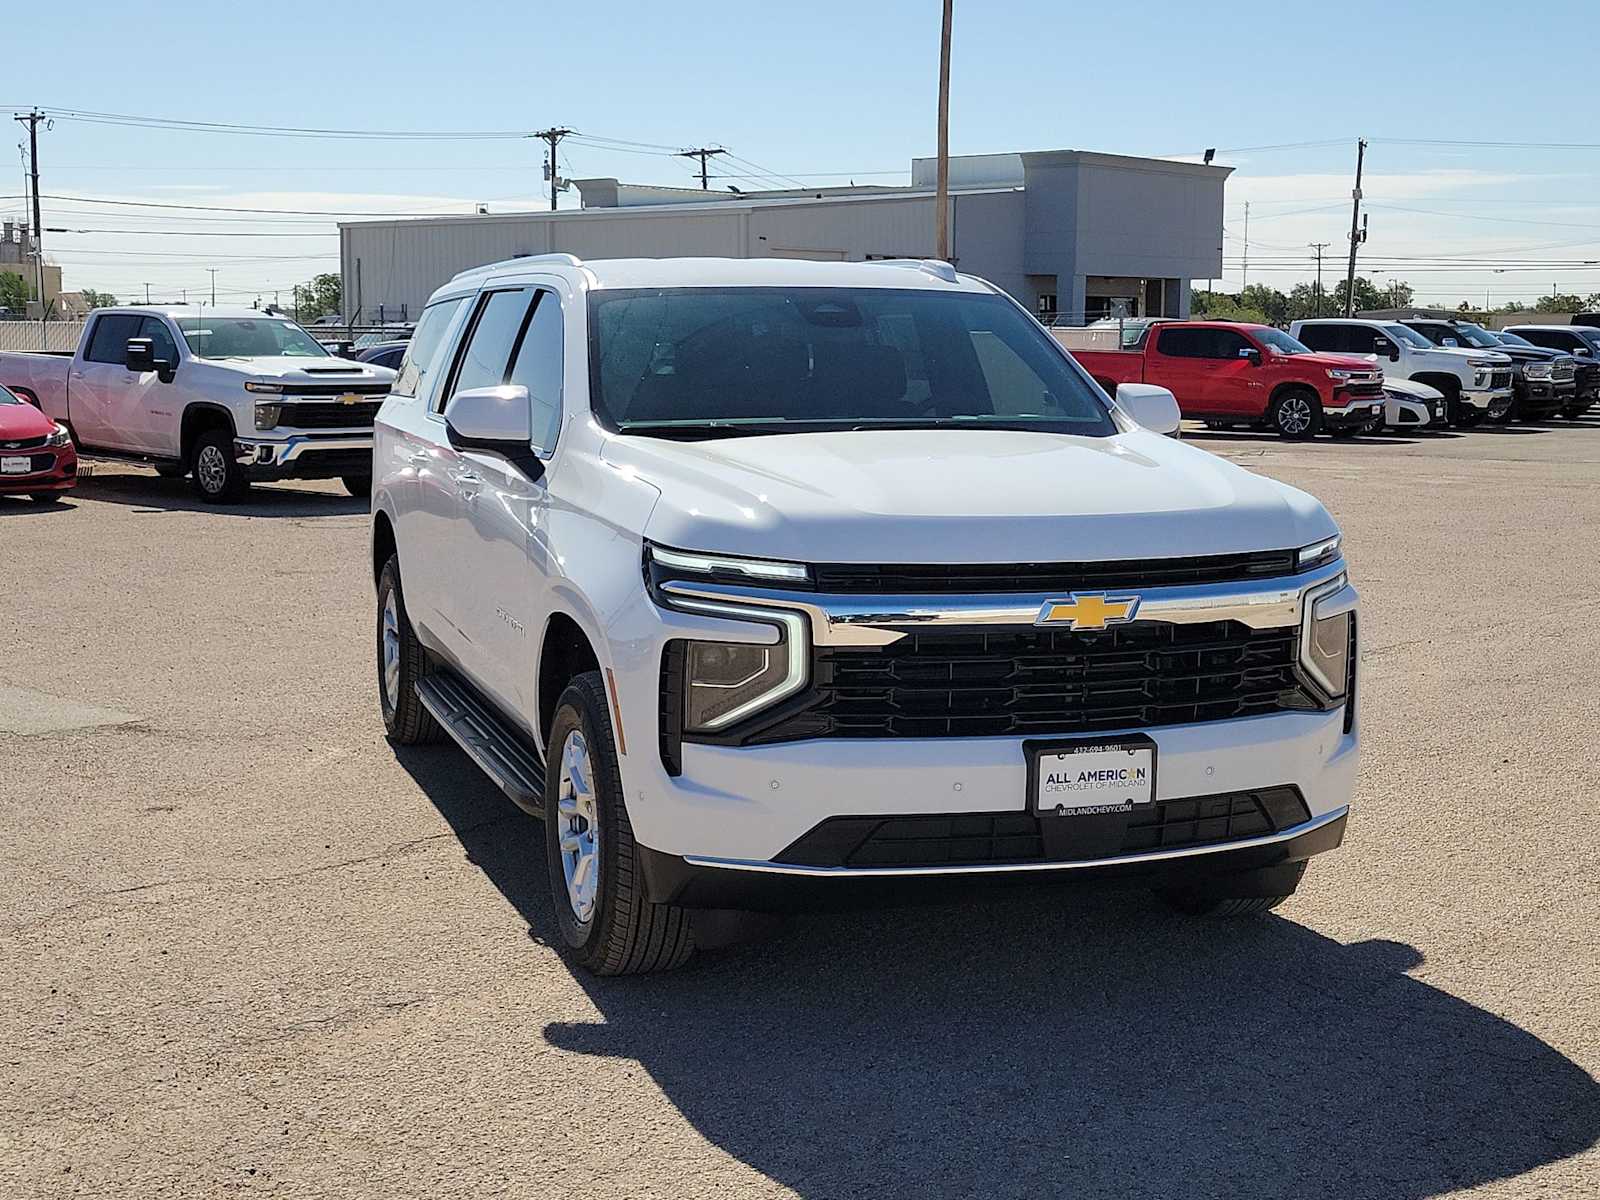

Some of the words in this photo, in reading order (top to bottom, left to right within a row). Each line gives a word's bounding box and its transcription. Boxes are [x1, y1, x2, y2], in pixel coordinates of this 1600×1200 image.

[1074, 744, 1122, 754] 432-694-9601
[1045, 782, 1093, 793] CHEVROLET
[1096, 781, 1107, 790] OF
[1109, 778, 1145, 789] MIDLAND
[1046, 773, 1071, 785] ALL
[1059, 803, 1132, 817] MIDLANDCHEVY.COM
